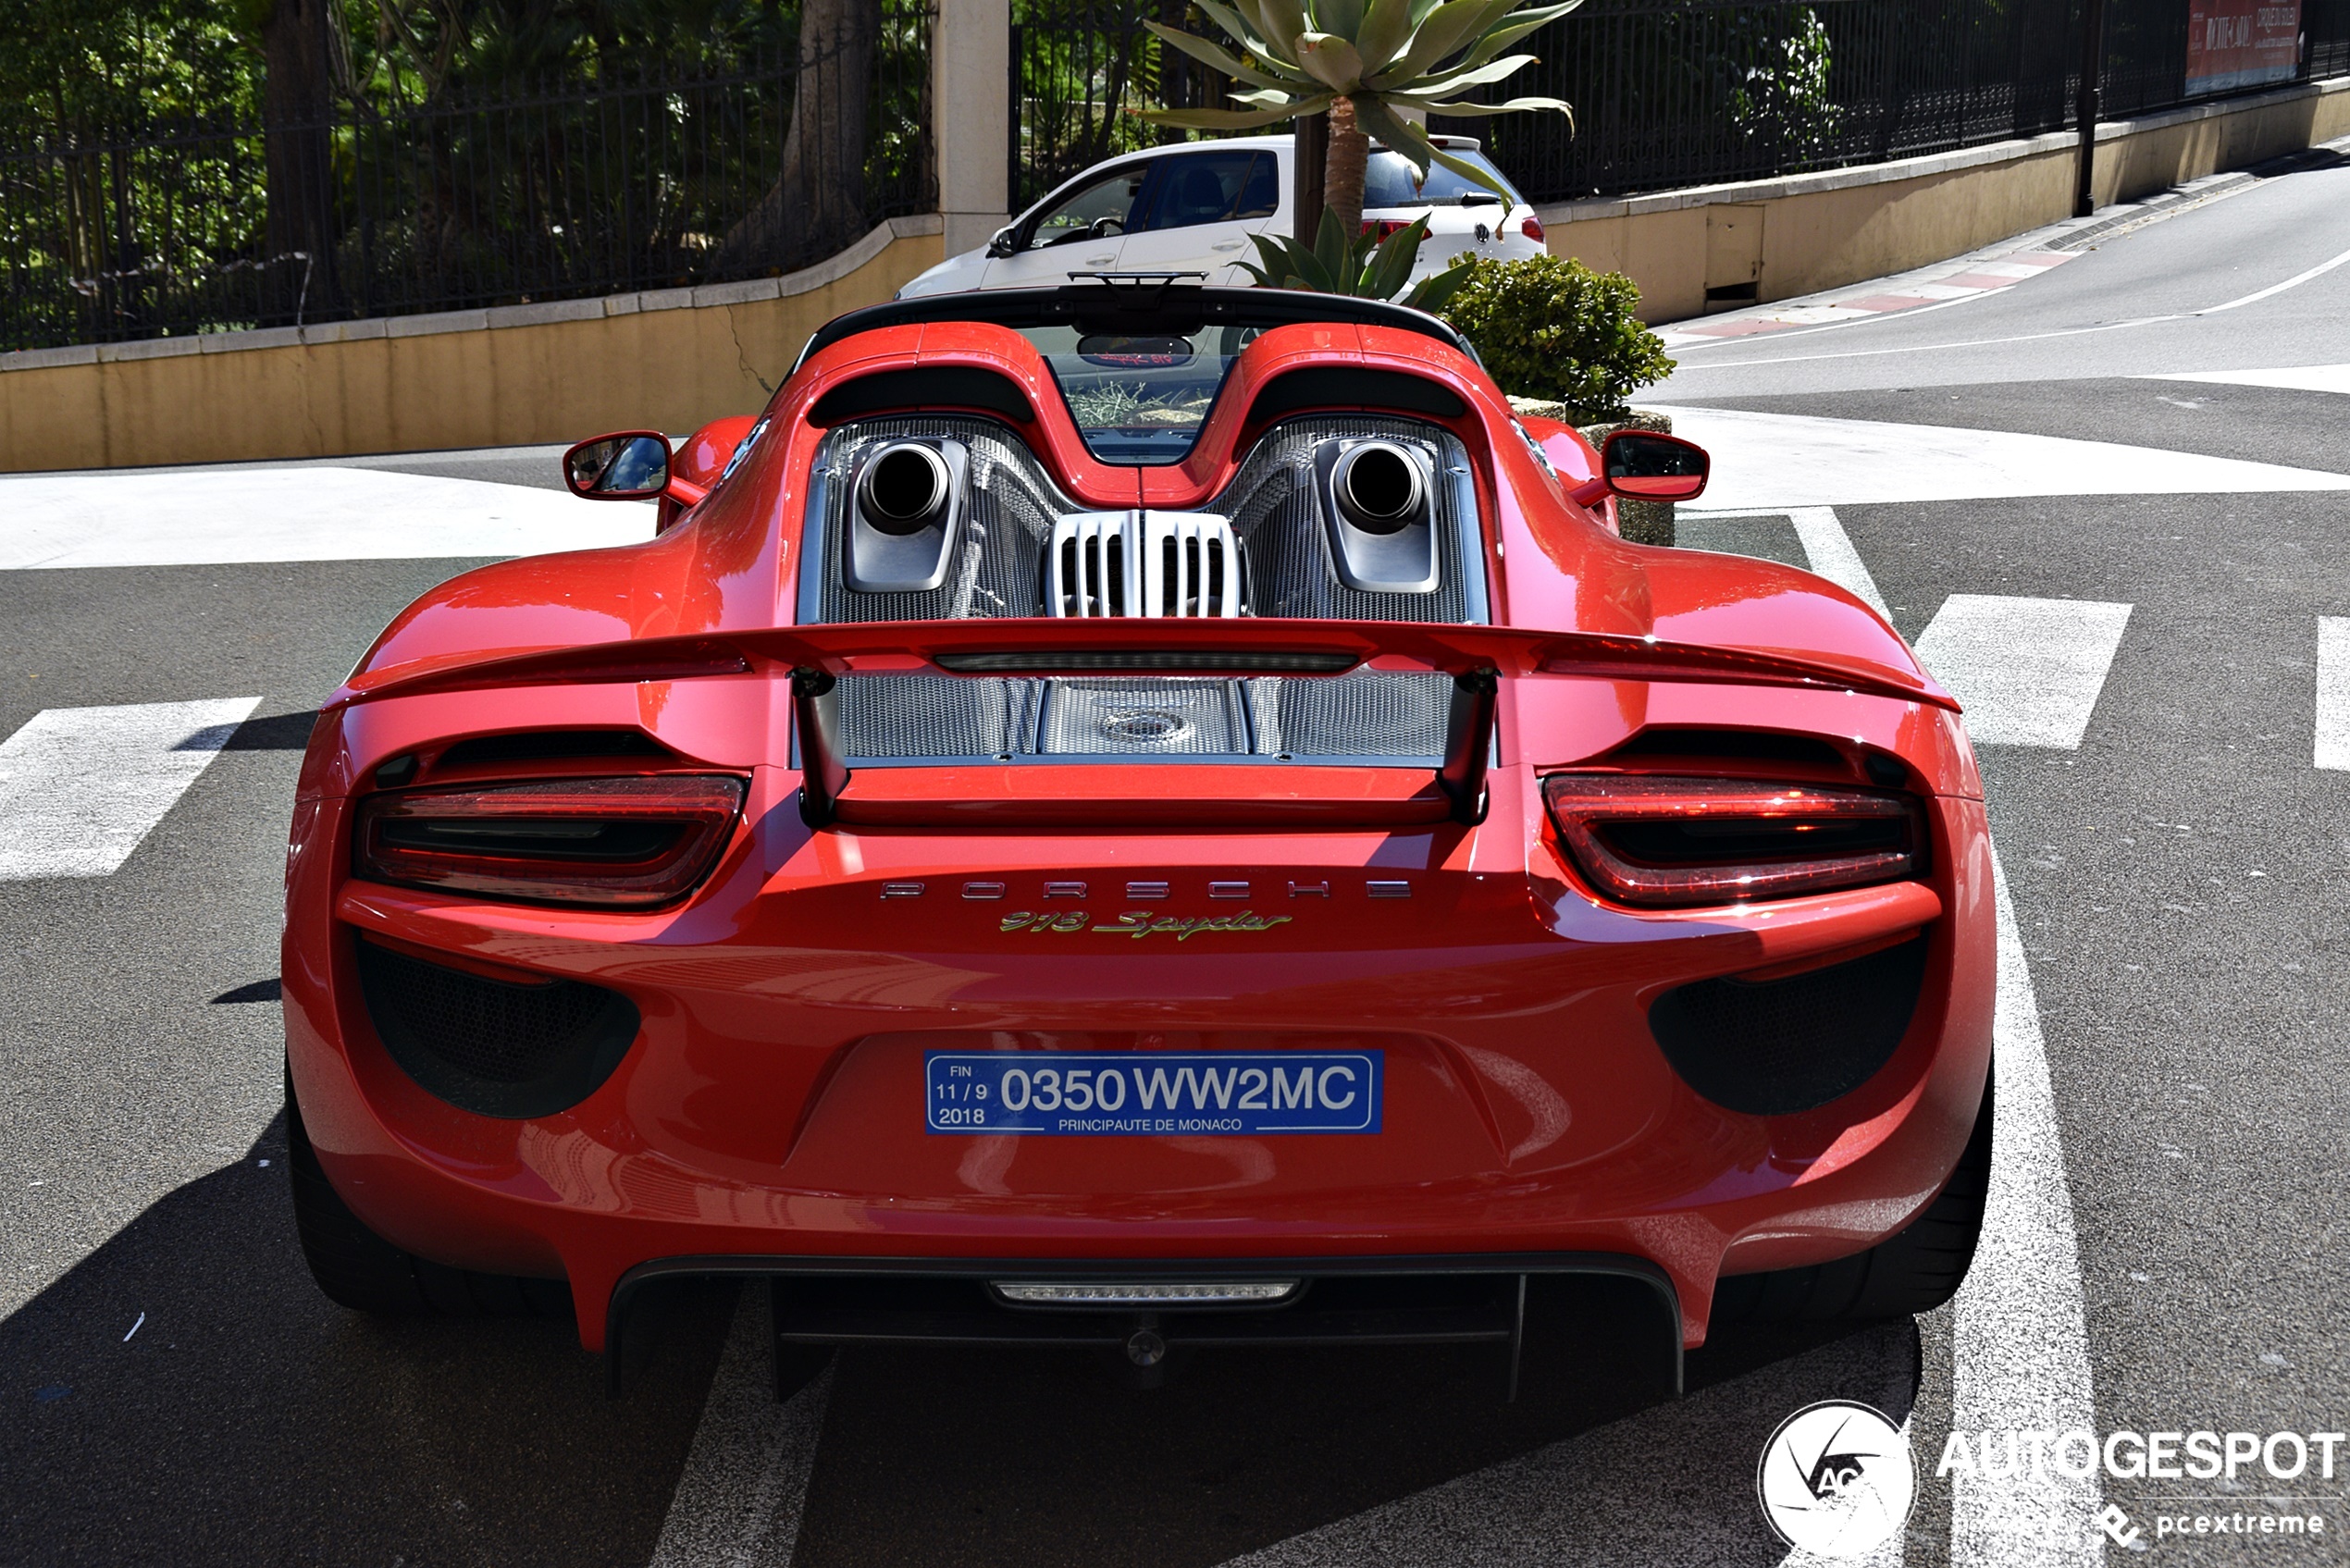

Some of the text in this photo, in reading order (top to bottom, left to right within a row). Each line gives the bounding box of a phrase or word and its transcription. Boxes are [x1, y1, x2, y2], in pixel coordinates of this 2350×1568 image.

[880, 881, 1411, 899] PORSCHE
[1000, 910, 1292, 941] 918 Spyder
[950, 1066, 971, 1077] FIN
[1001, 1066, 1355, 1111] 0350 WW2MC
[939, 1108, 985, 1125] 2018
[1058, 1118, 1243, 1131] PRINCIPAUTE DE MONACO
